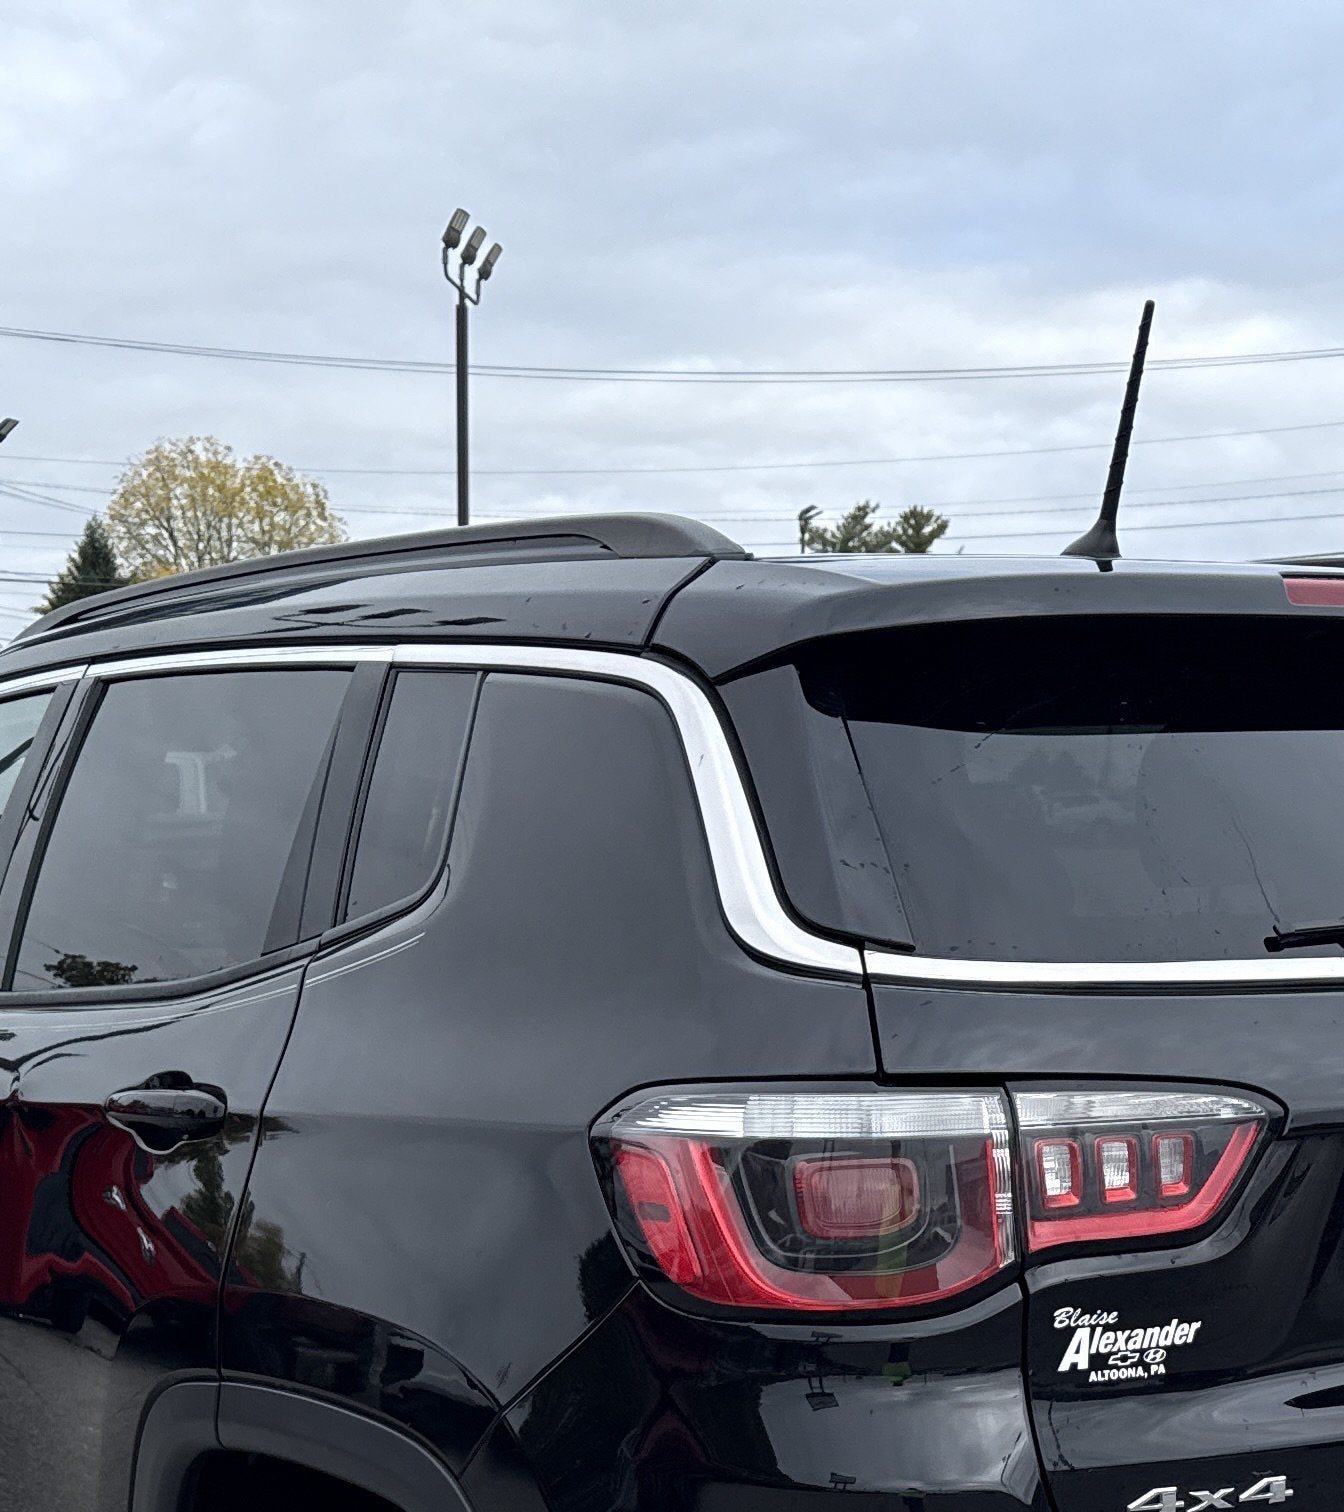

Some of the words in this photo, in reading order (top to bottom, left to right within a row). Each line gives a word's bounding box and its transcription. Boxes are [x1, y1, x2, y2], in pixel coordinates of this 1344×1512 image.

[1053, 1306, 1119, 1329] Blaise
[1057, 1318, 1202, 1372] Alexander
[1088, 1366, 1148, 1383] ALTOONA,
[1150, 1363, 1166, 1376] PA
